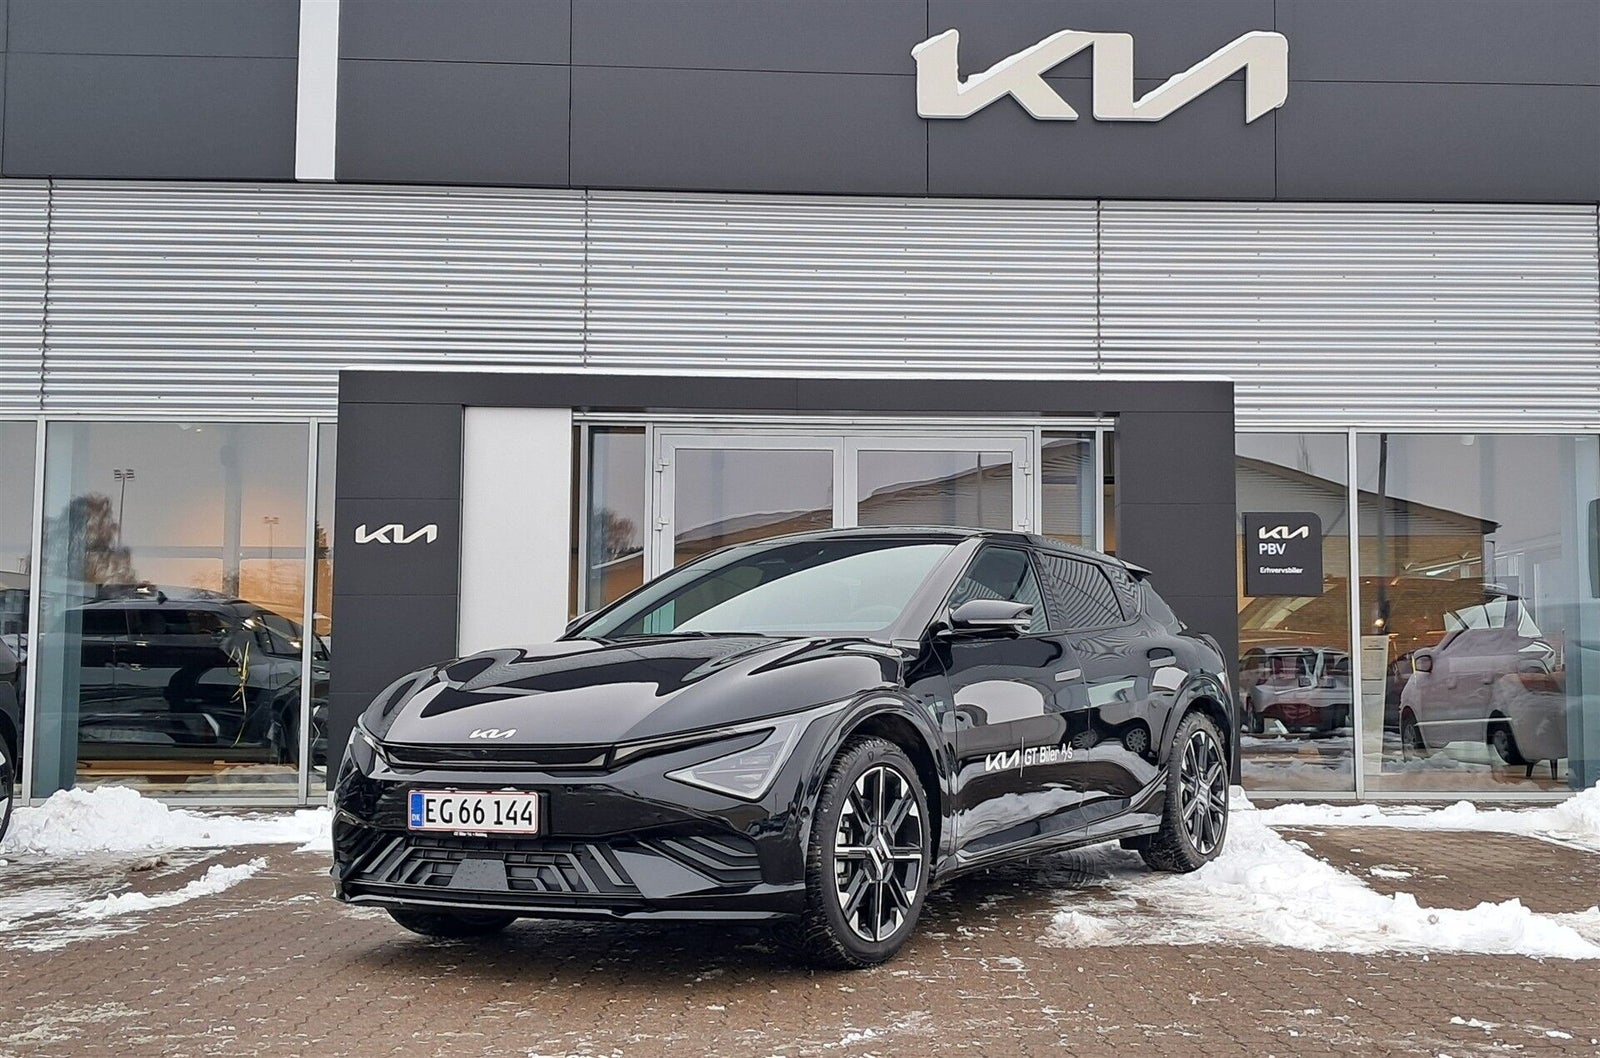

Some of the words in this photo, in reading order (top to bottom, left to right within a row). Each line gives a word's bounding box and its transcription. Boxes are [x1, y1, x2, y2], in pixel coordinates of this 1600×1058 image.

[911, 29, 1289, 124] KIA
[355, 524, 437, 544] KIA
[1258, 526, 1309, 539] KIA
[1258, 543, 1287, 555] PBV
[1024, 747, 1038, 766] GT
[1039, 746, 1060, 763] Biler
[411, 813, 421, 822] DK
[425, 798, 453, 824] EG
[458, 798, 485, 825] 66
[493, 799, 533, 826] 144
